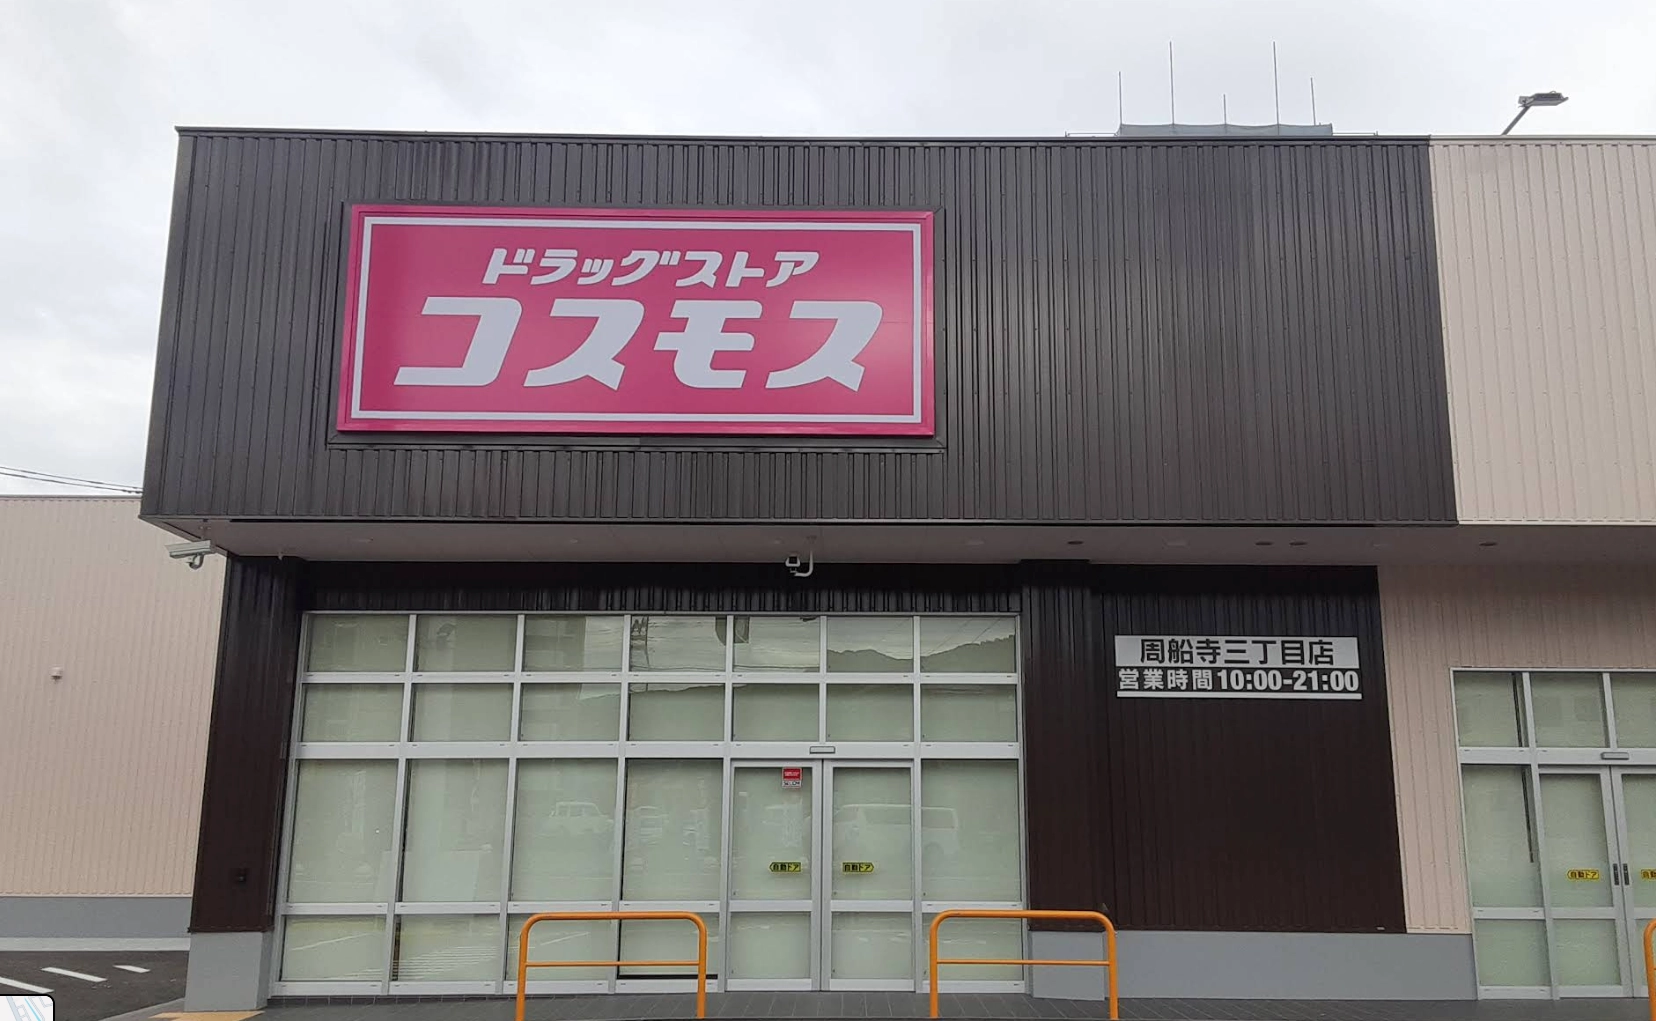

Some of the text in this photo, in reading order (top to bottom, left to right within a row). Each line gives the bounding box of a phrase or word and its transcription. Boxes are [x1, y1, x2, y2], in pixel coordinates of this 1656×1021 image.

[483, 248, 820, 287] ドラッグストア
[394, 296, 884, 392] コスモス
[1140, 638, 1334, 666] 周船寺三丁目店
